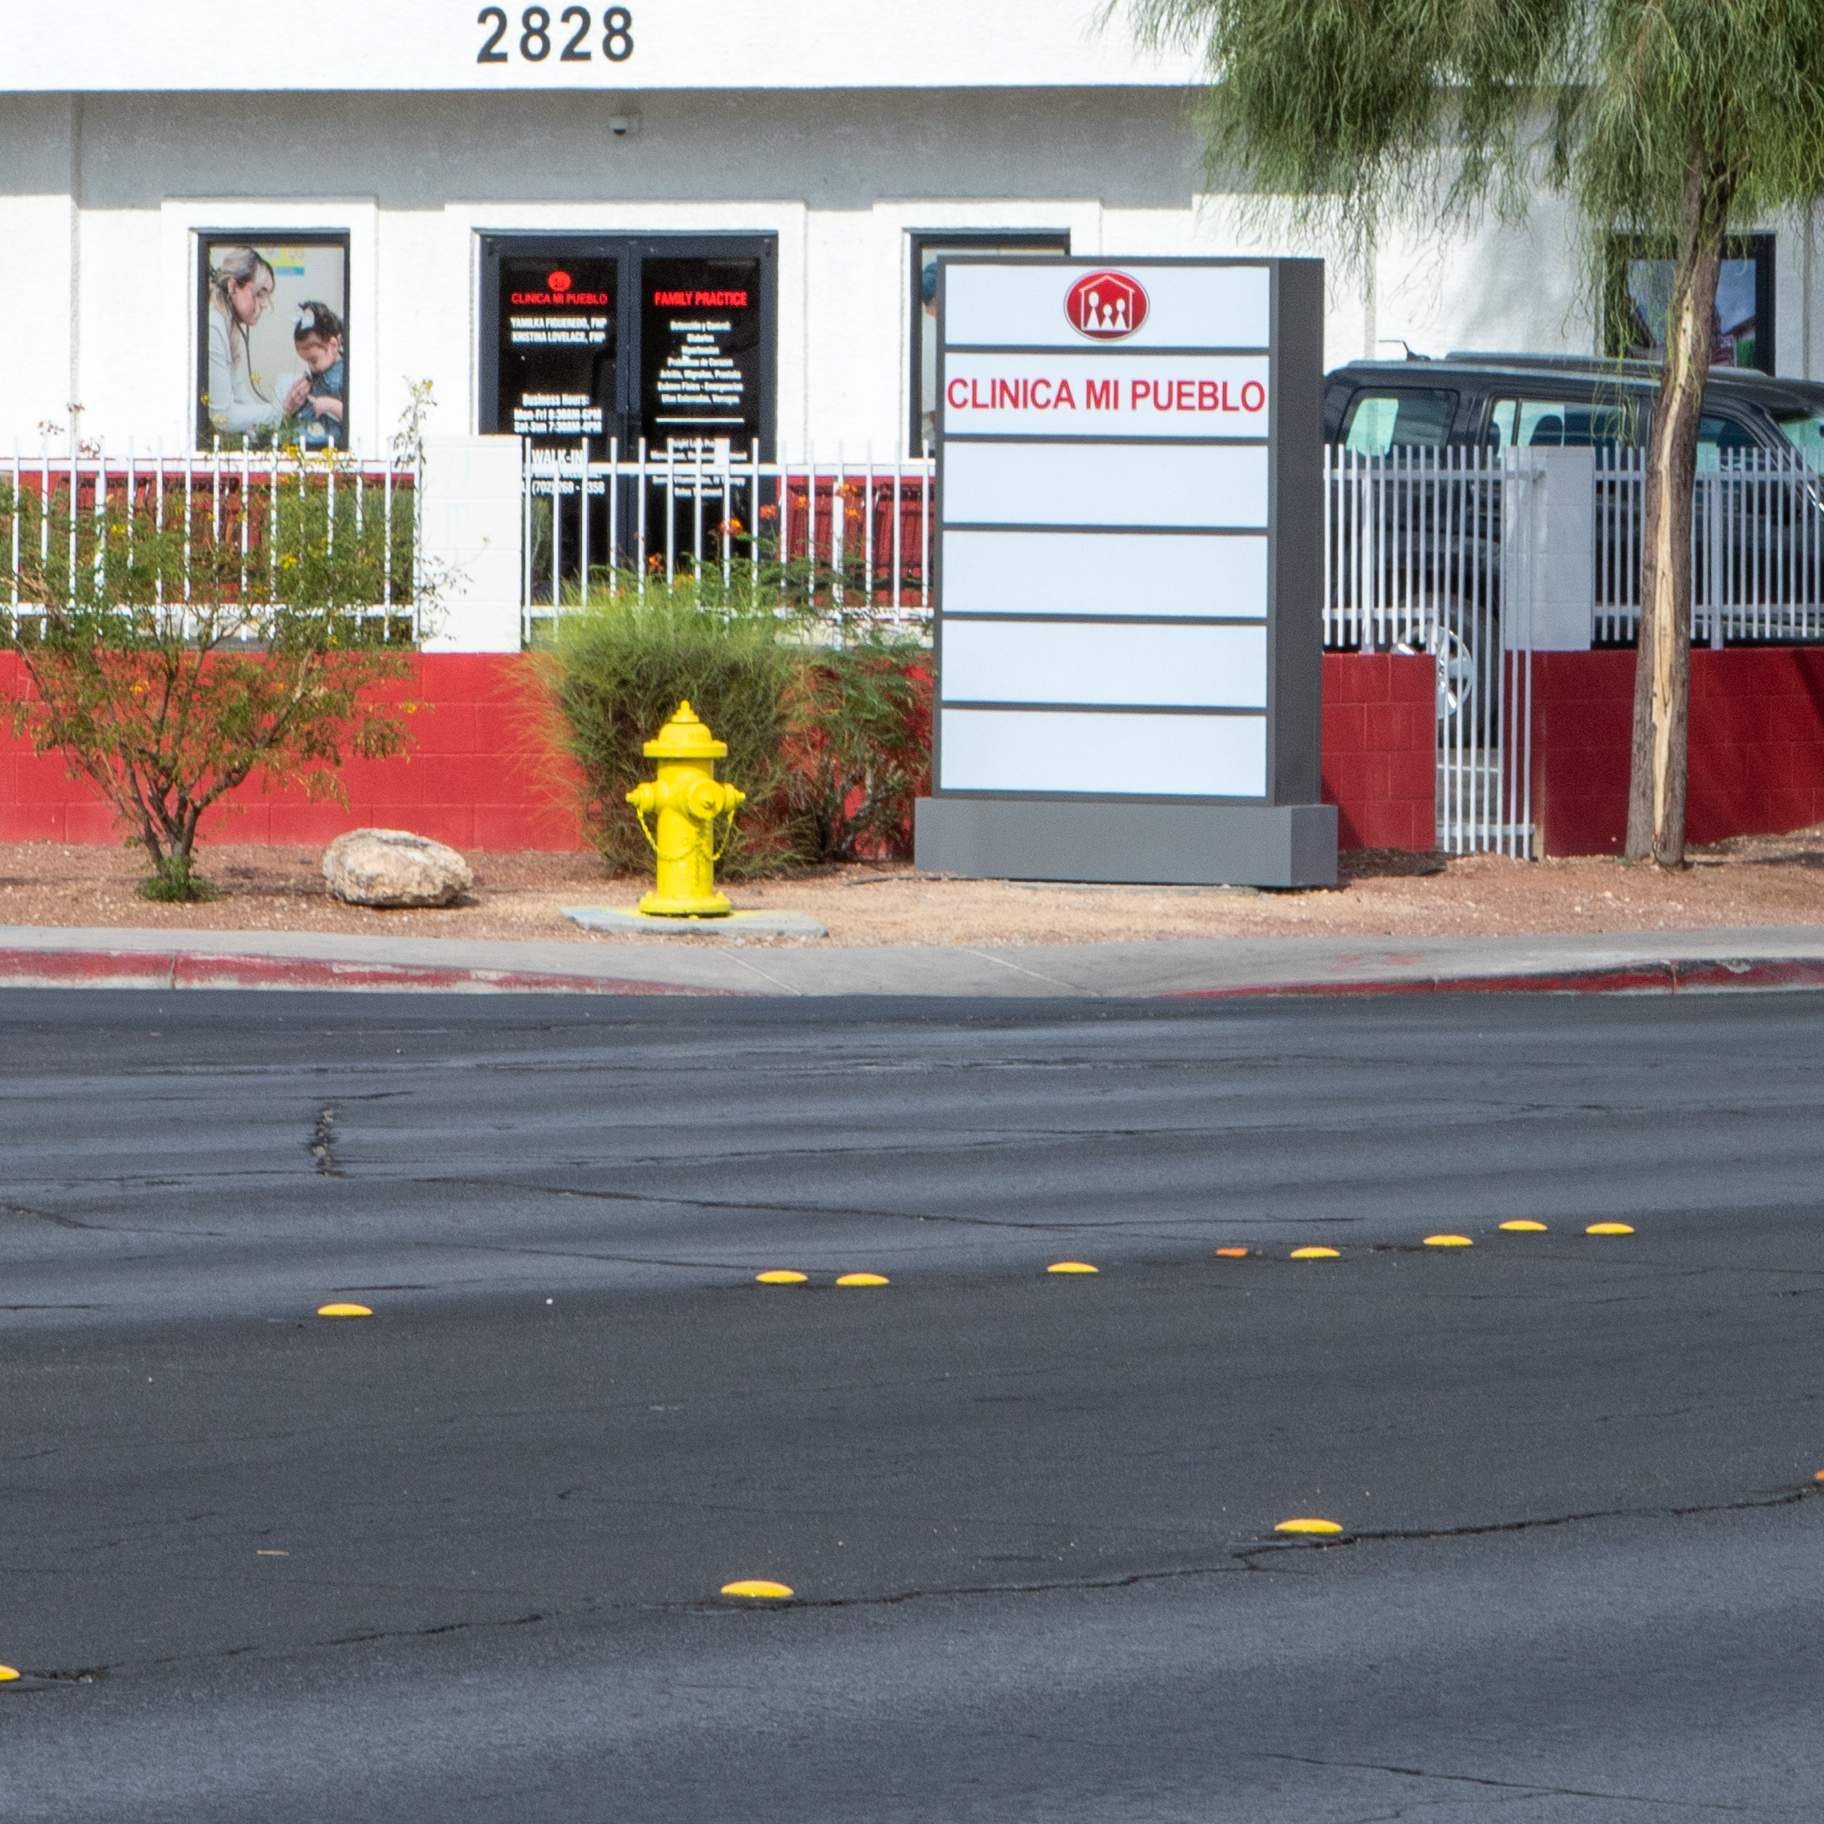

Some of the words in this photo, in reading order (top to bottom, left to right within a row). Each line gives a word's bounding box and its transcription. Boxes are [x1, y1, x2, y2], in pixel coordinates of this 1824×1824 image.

[477, 6, 634, 63] 2828
[511, 292, 550, 305] CLINICA
[553, 292, 564, 305] MI
[566, 292, 608, 305] PUEBLO
[653, 290, 693, 307] FAMILY
[694, 290, 748, 307] PRACTICE
[946, 378, 1076, 410] CLINICA
[1084, 379, 1120, 411] MI
[1130, 379, 1266, 413] PUEBLO
